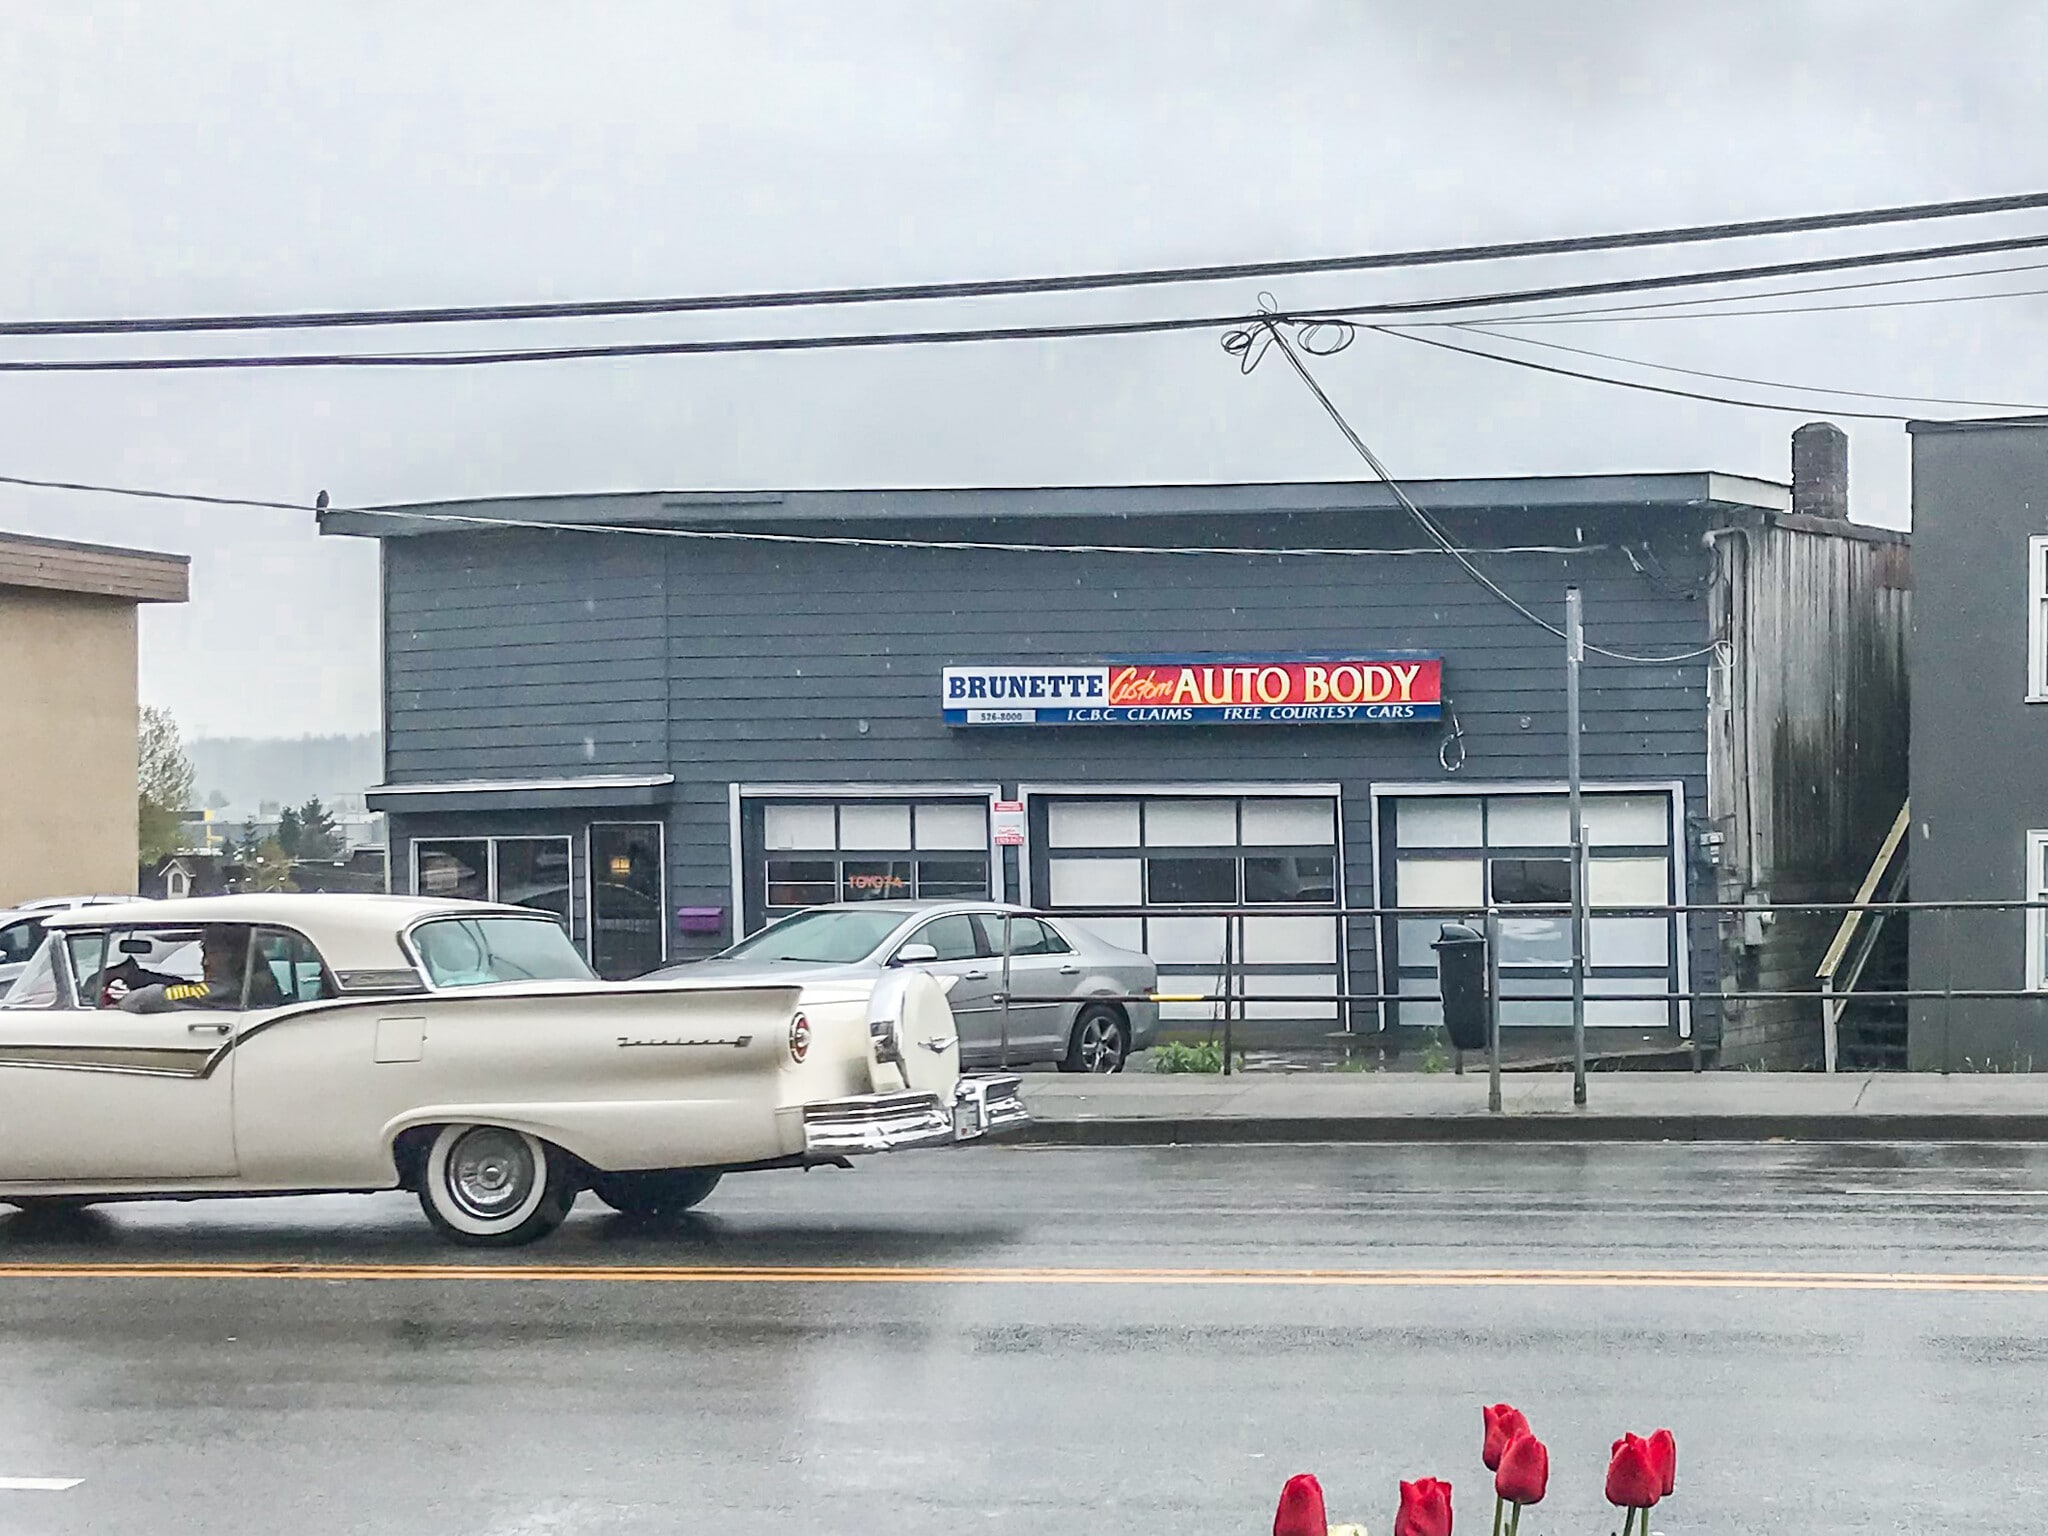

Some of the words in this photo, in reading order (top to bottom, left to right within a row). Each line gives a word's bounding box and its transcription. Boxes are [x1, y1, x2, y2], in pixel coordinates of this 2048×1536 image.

[949, 675, 1103, 698] BRUNETTE
[1110, 667, 1174, 704] Custom
[1171, 667, 1291, 704] AUTO
[1303, 665, 1421, 703] BODY
[1127, 707, 1193, 721] CLAIMS
[1223, 706, 1262, 720] FREE
[1269, 705, 1357, 719] COURTESY
[1366, 705, 1415, 718] CARS
